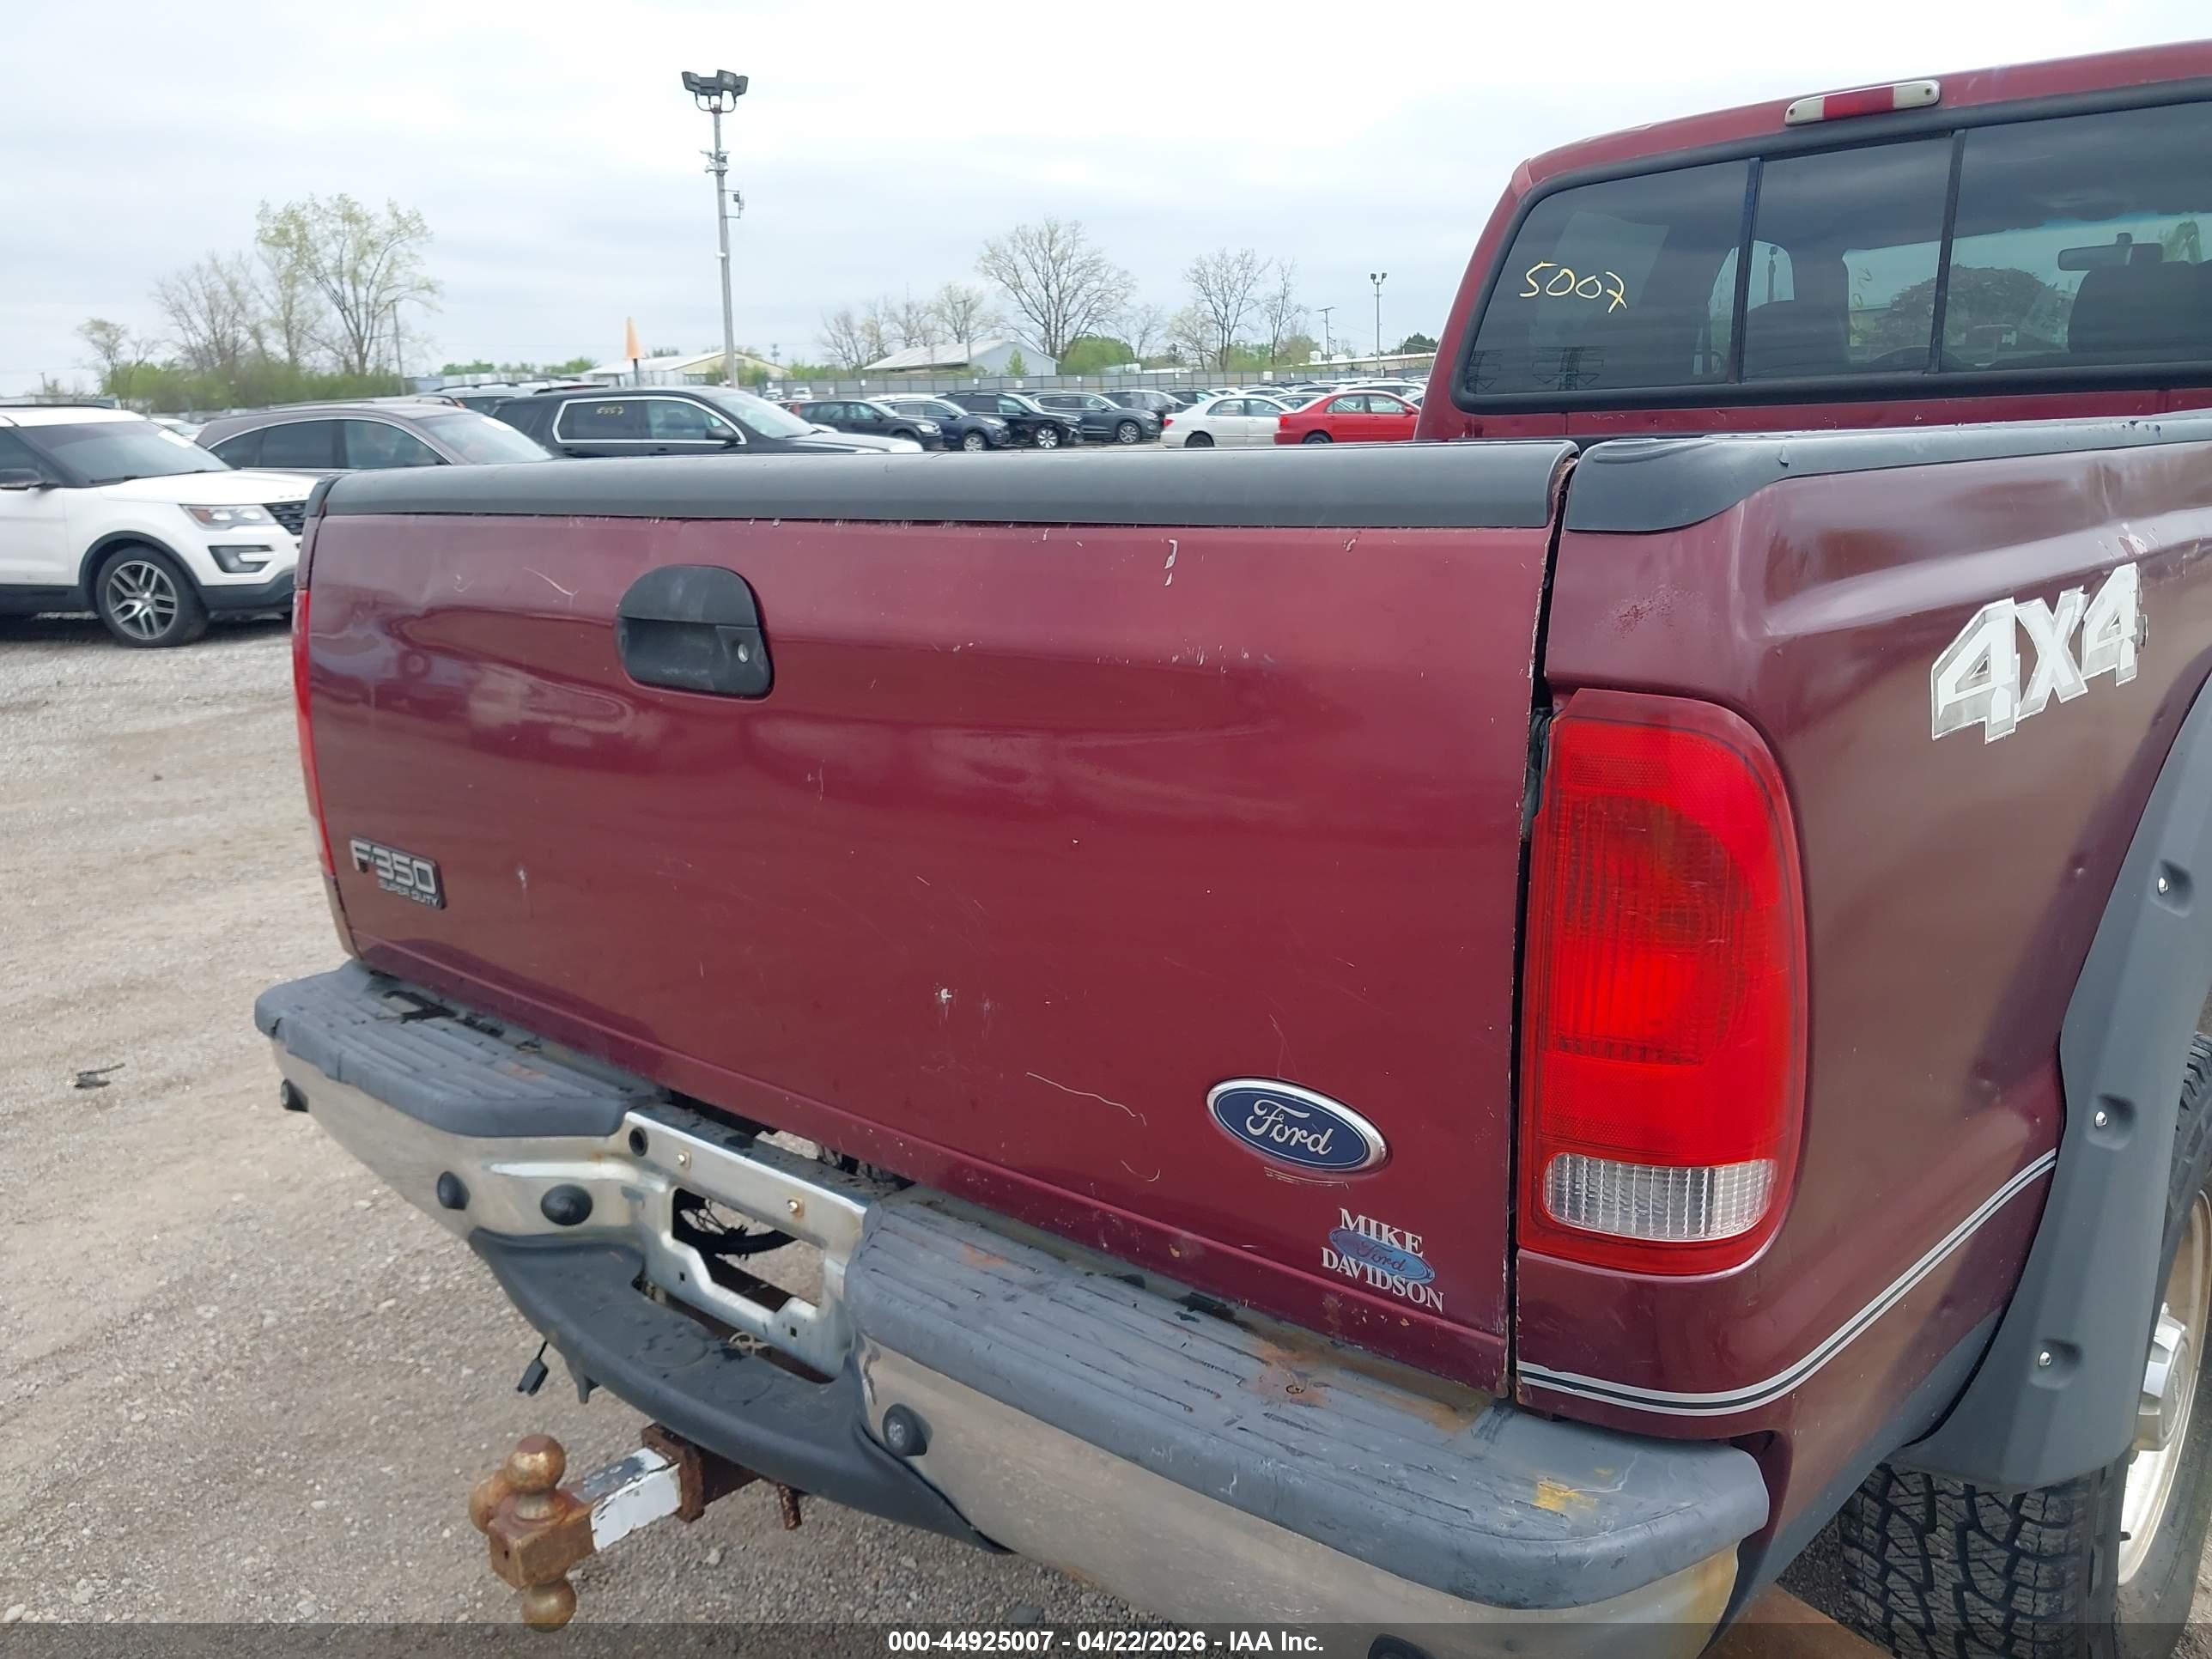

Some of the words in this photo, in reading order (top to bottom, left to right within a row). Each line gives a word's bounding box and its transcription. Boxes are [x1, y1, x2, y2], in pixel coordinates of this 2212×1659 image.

[1518, 261, 1628, 314] 5007
[411, 890, 440, 908] DUTY
[1245, 1097, 1334, 1157] Ford
[1340, 1207, 1424, 1258] MIKE
[1357, 1240, 1407, 1272] Ford
[1321, 1246, 1444, 1313] DAVIDSON
